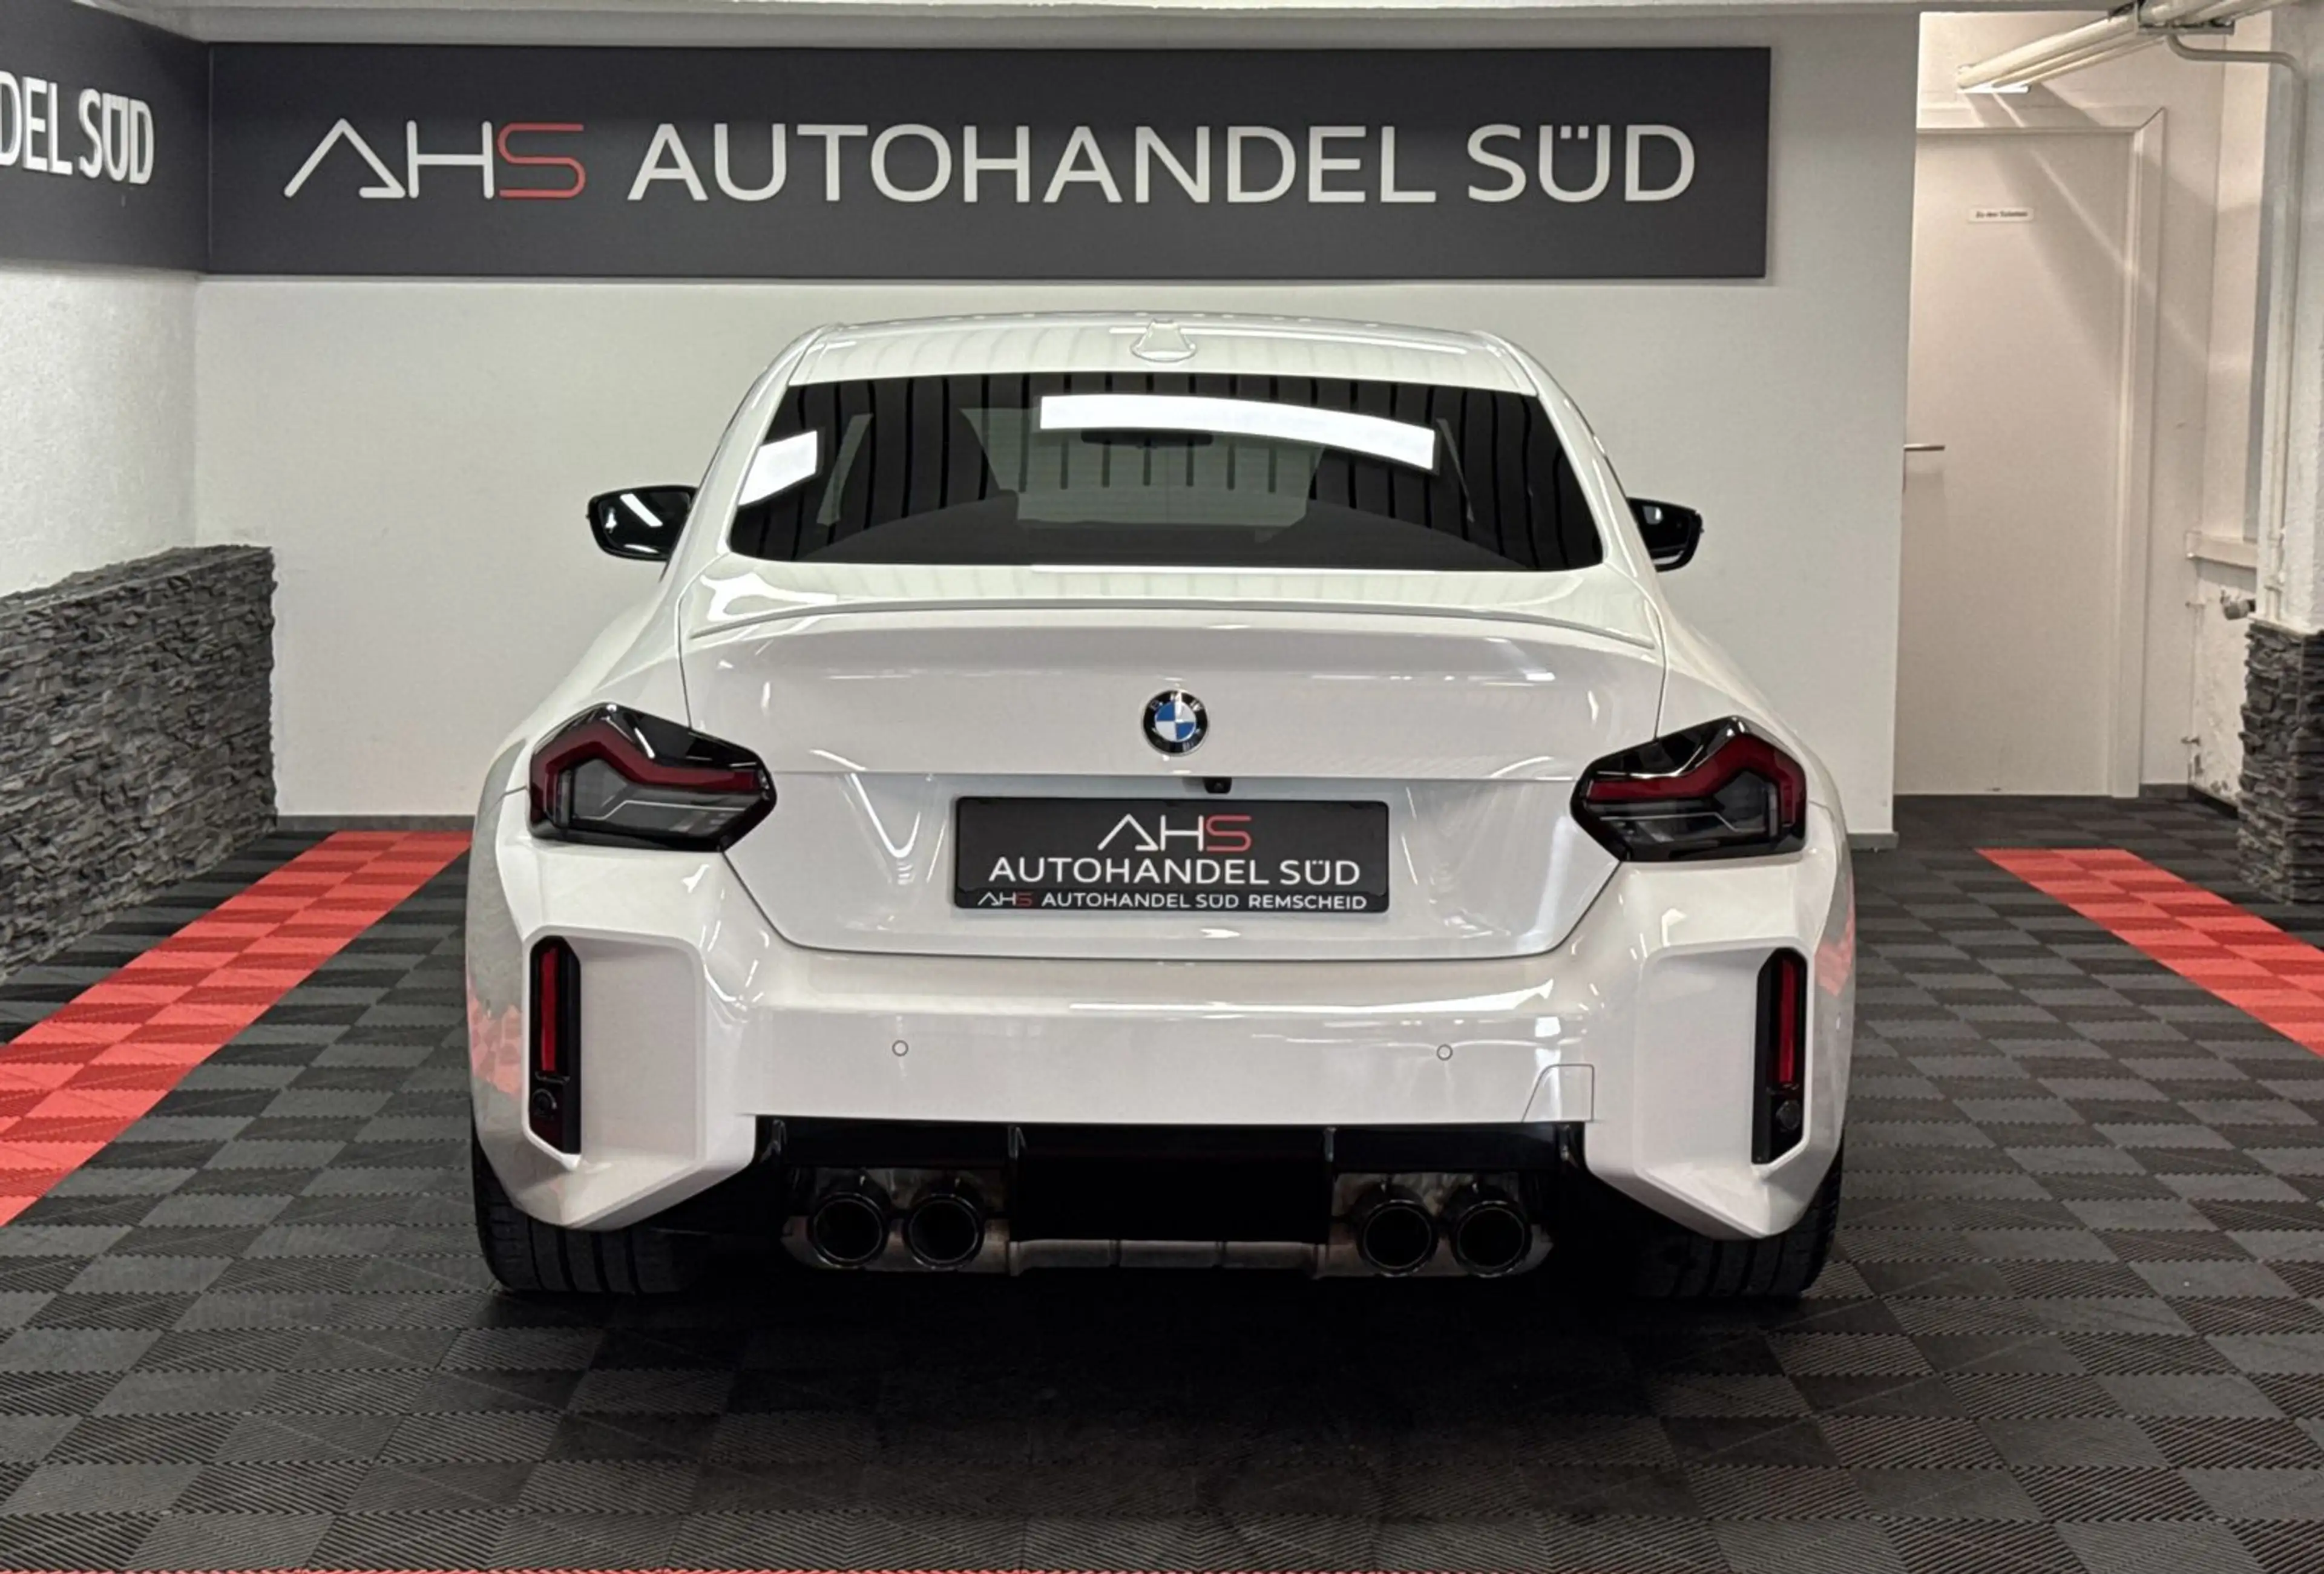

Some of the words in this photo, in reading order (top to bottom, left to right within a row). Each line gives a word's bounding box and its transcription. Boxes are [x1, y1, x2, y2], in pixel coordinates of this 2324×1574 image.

[78, 88, 154, 184] SÜD
[283, 119, 586, 199] AHS
[626, 123, 1437, 203] AUTOHANDEL
[1467, 124, 1695, 203] SÜD
[1097, 813, 1252, 852] AHS
[988, 856, 1270, 885] AUTOHANDEL
[1279, 859, 1361, 886] SÜD
[977, 891, 1033, 907] AHS
[1041, 893, 1191, 908] AUTOHANDEL
[1195, 893, 1239, 909] SÜD
[1248, 894, 1368, 910] REMSCHEID
